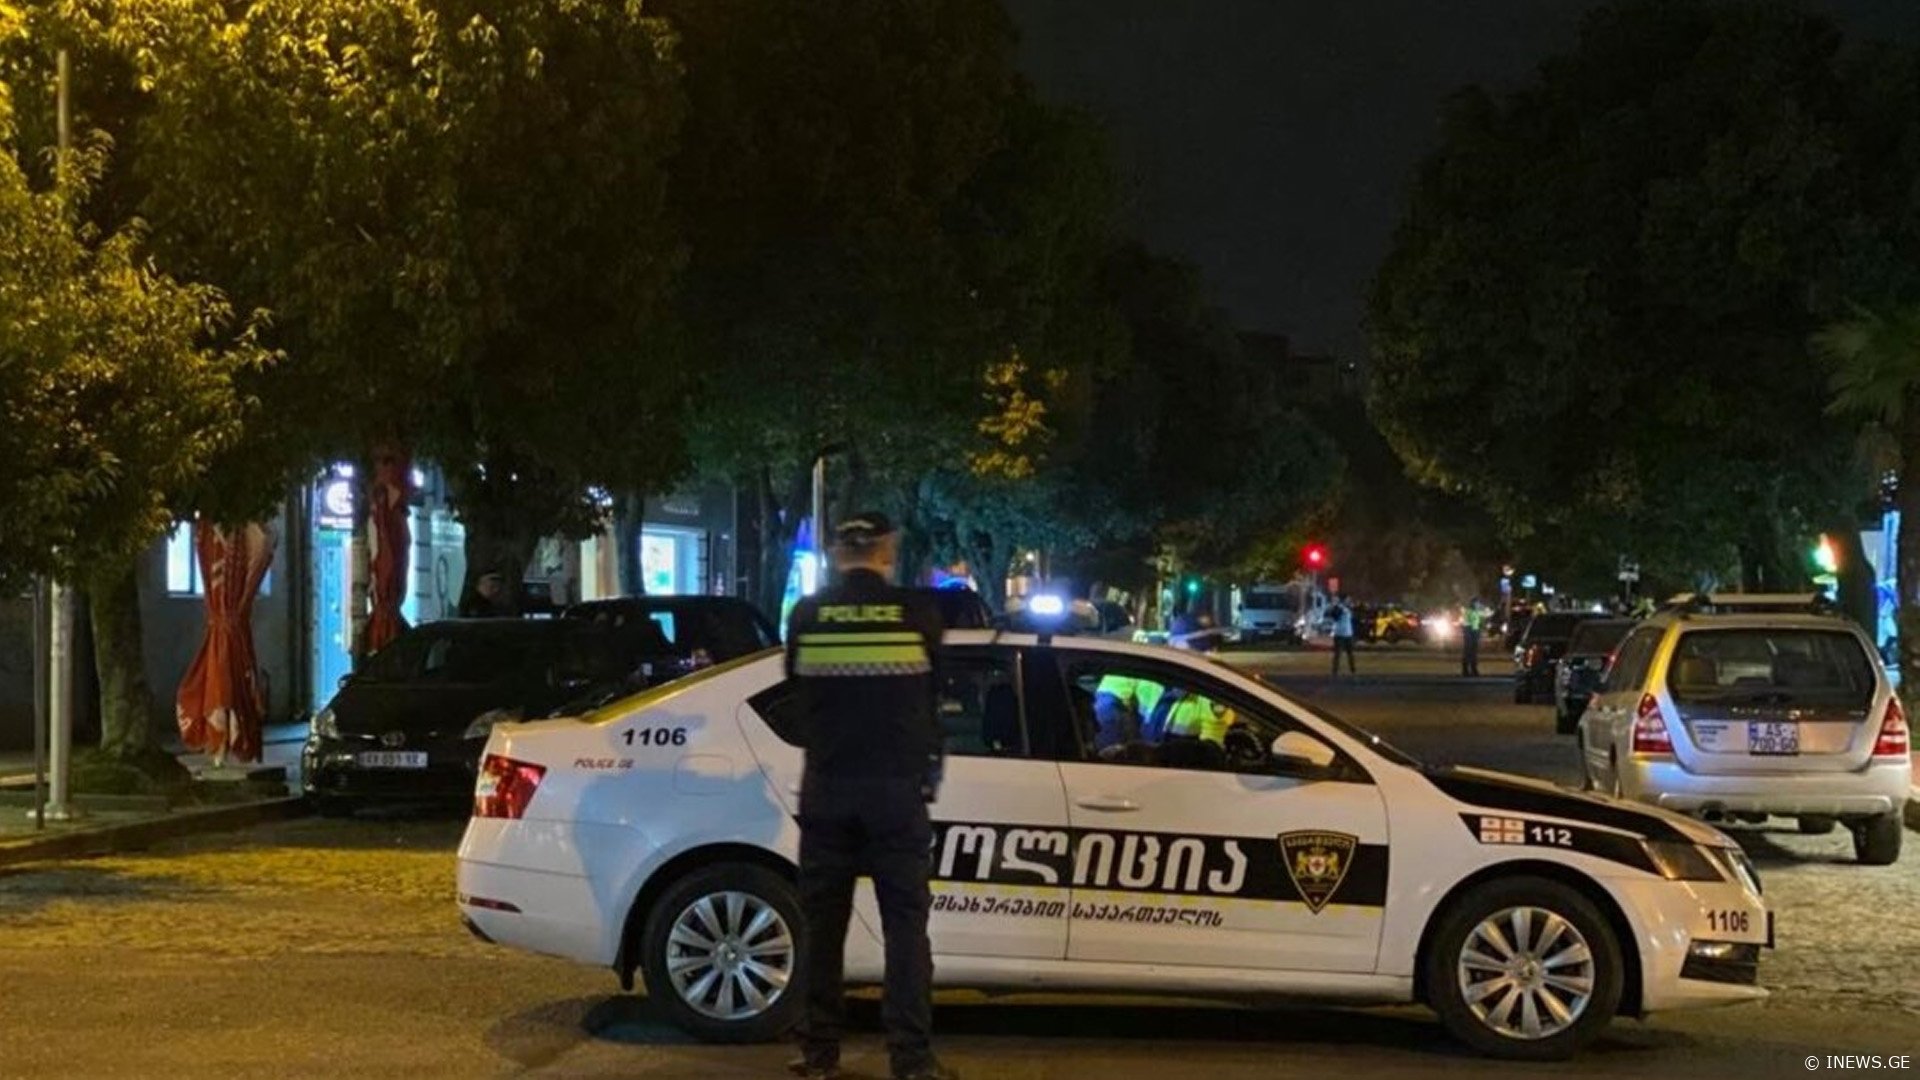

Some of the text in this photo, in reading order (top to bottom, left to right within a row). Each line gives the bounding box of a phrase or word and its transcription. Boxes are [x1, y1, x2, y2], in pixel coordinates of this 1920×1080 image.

[817, 604, 904, 623] POLICE
[621, 726, 689, 746] 1106
[1530, 826, 1573, 847] 112
[929, 824, 1249, 894] ოლიცია
[930, 894, 1224, 928] მსახურებით საქართველოს
[1706, 908, 1750, 933] 1106
